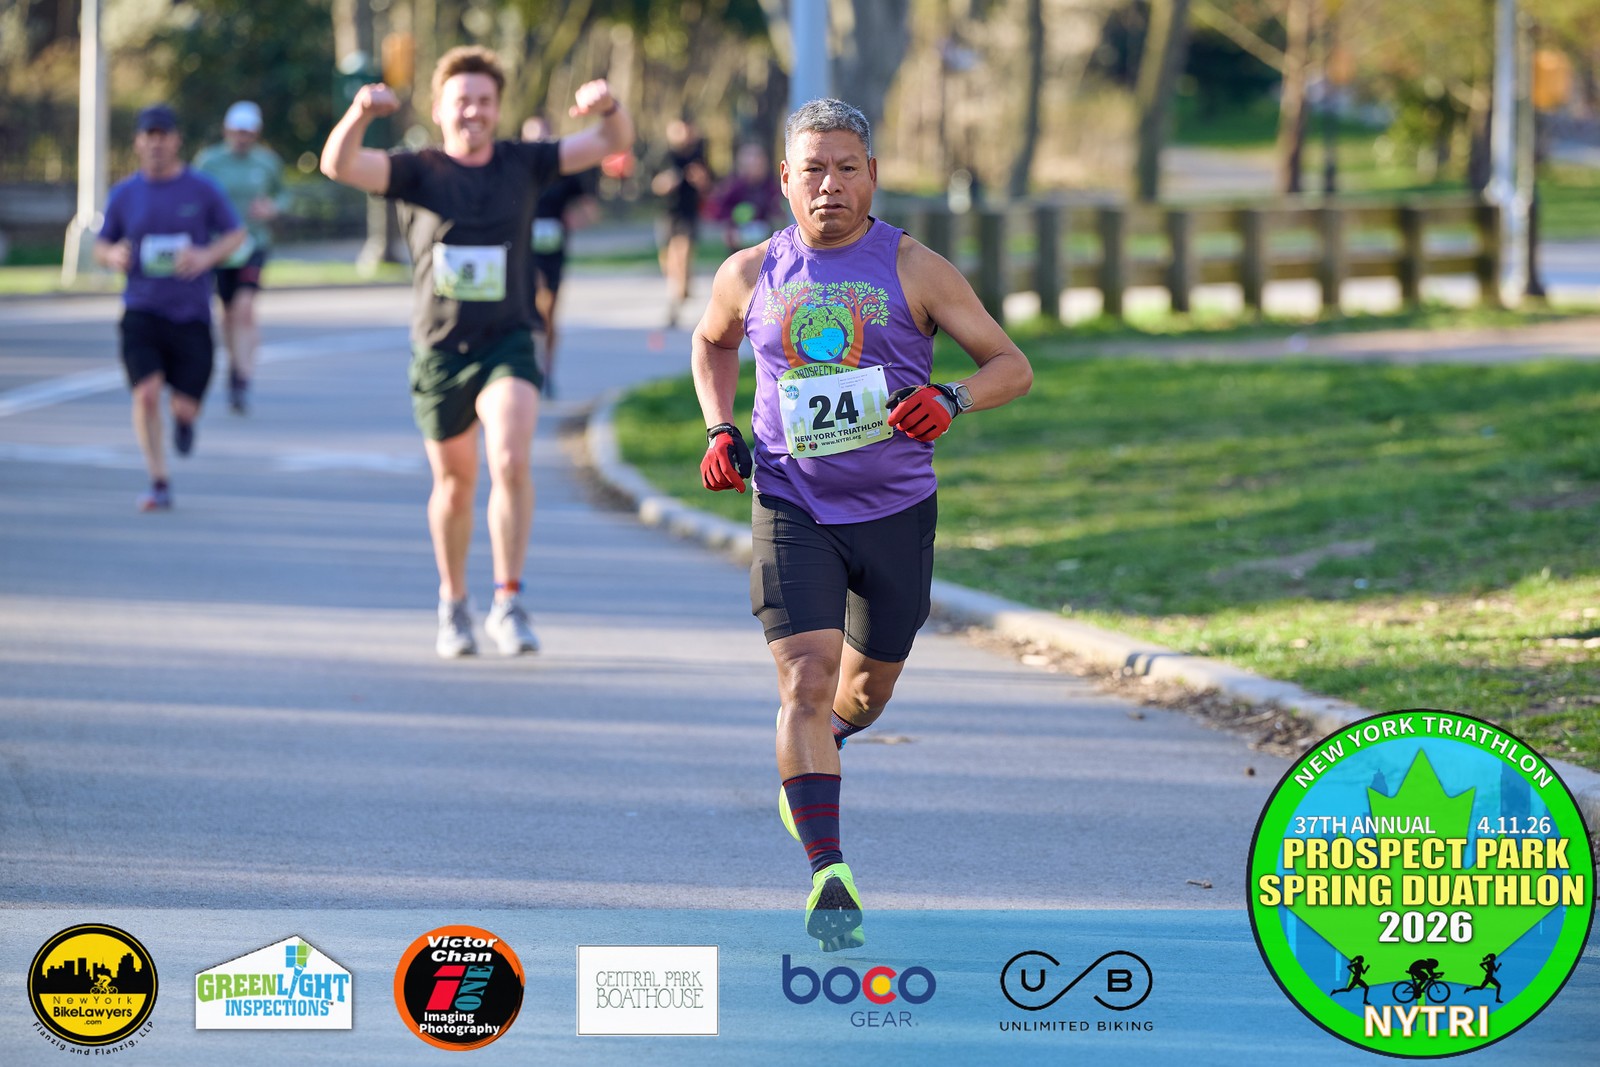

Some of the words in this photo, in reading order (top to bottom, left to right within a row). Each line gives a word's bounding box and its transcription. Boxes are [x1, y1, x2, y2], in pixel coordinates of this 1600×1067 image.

[794, 365, 833, 379] PROSPECT
[808, 390, 860, 431] 24
[794, 434, 812, 443] NEW
[813, 431, 837, 441] YORK
[838, 420, 884, 437] TRIATHLON
[821, 435, 862, 446] www.NYTRI.org
